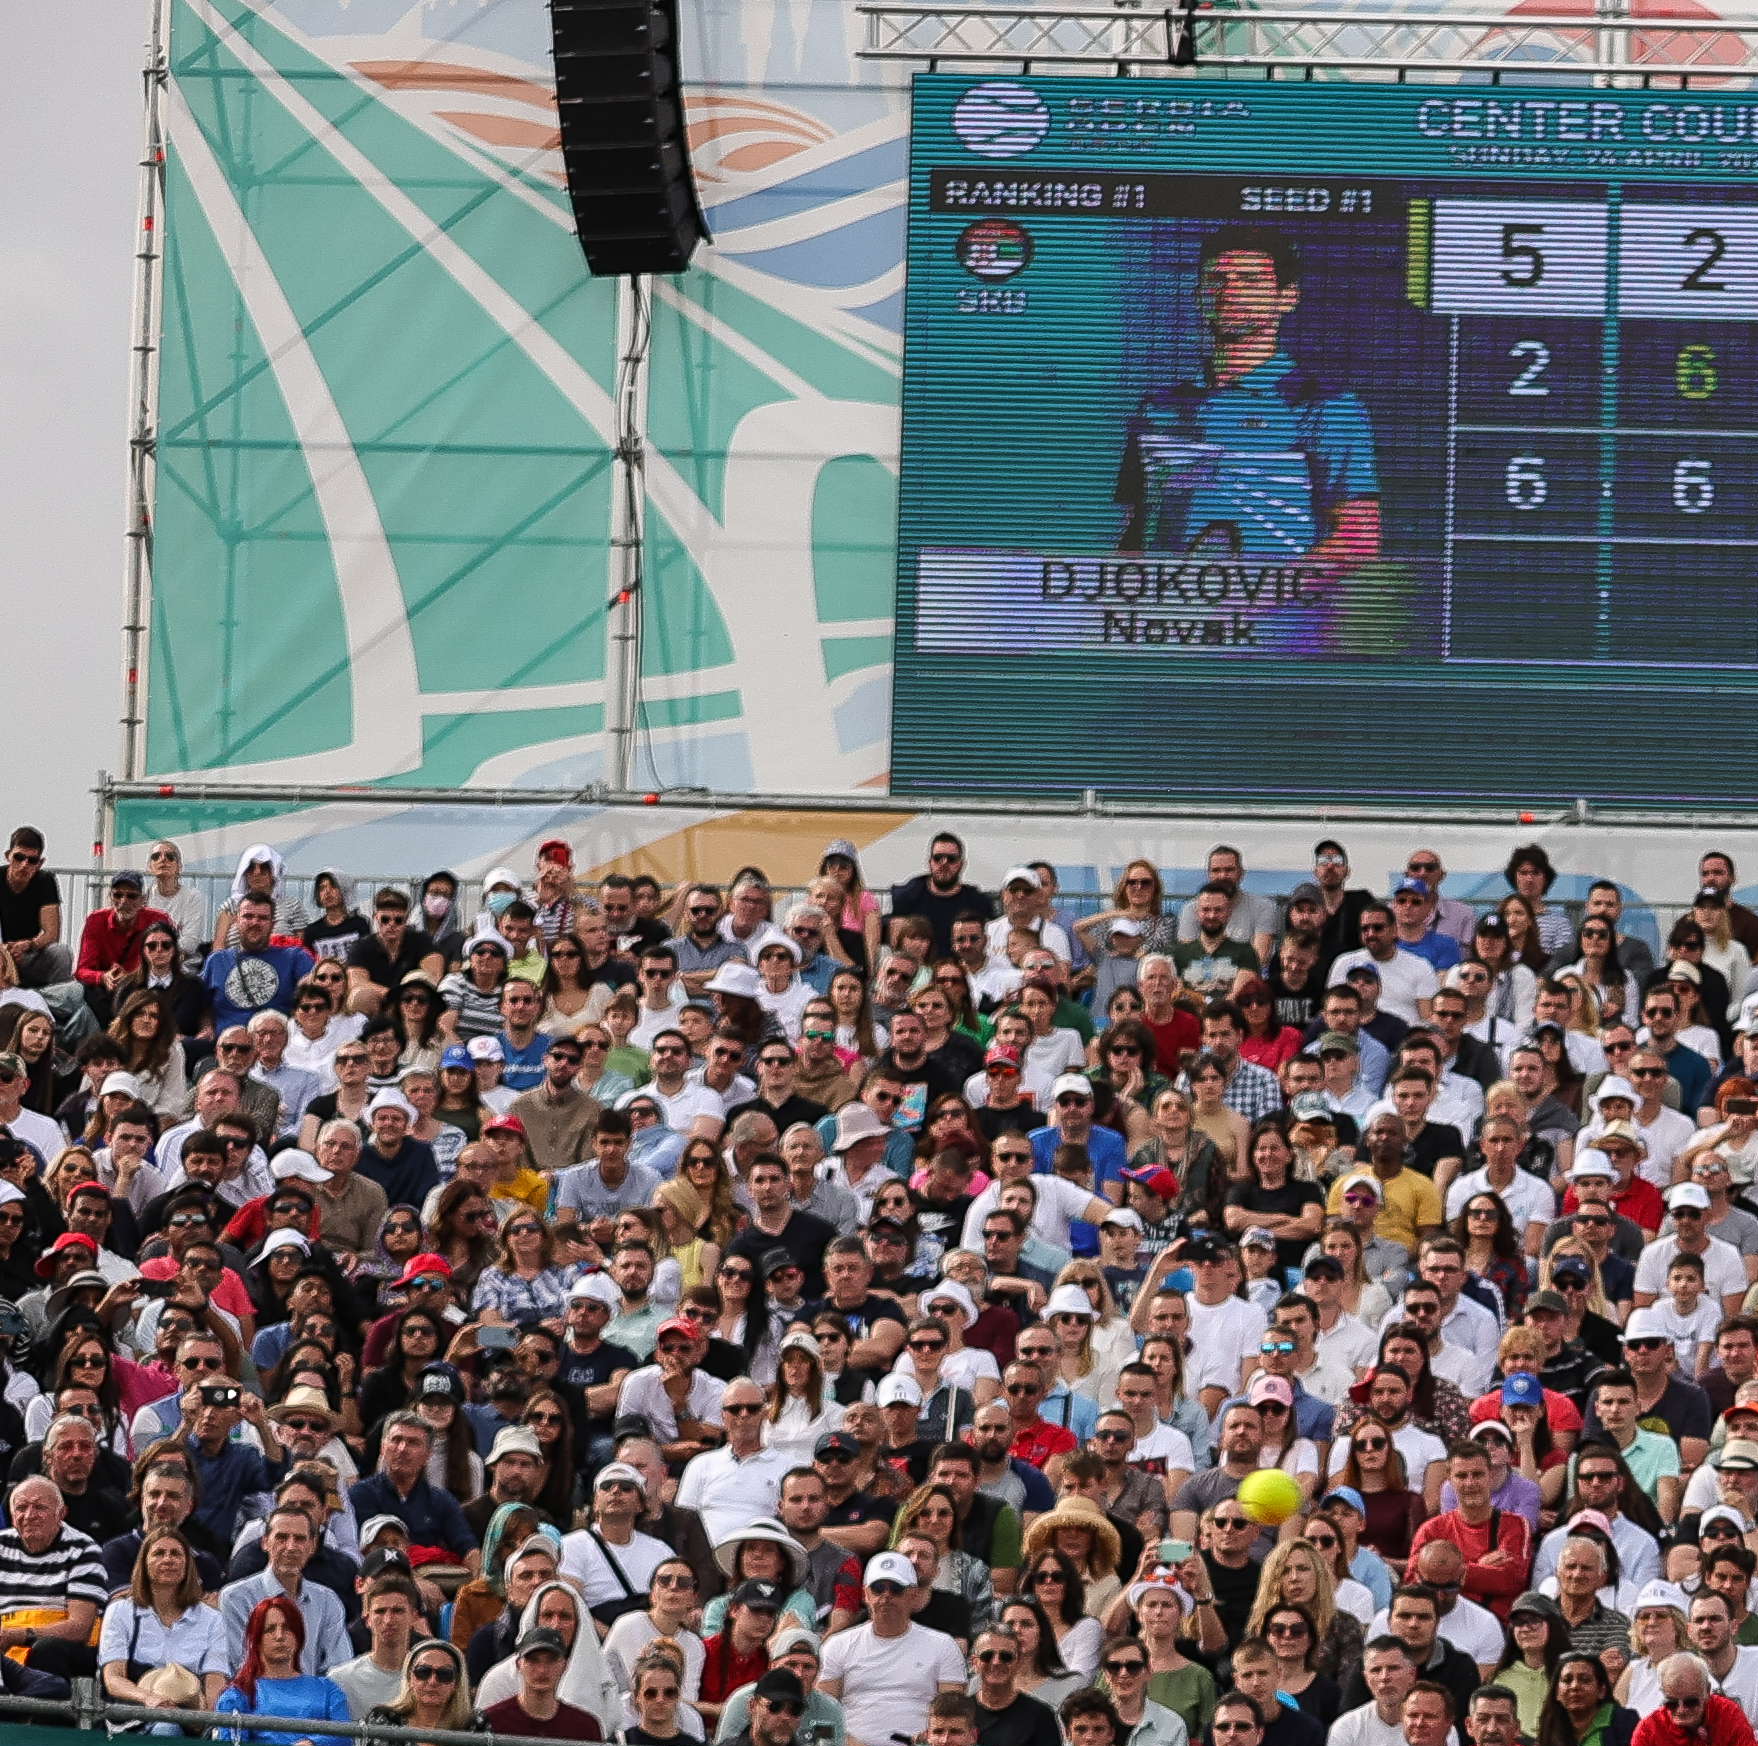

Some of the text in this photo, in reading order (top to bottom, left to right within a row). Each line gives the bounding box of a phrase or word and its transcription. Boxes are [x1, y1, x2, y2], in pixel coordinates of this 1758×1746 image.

[1418, 100, 1625, 141] CENTER
[943, 180, 1103, 208] RANKING
[1240, 185, 1332, 213] SEED
[1501, 224, 1545, 287] 5
[1680, 227, 1729, 291] 2
[1507, 339, 1551, 396] 2
[1675, 345, 1719, 399] 6
[1505, 454, 1549, 510] 6
[1673, 459, 1715, 513] 6
